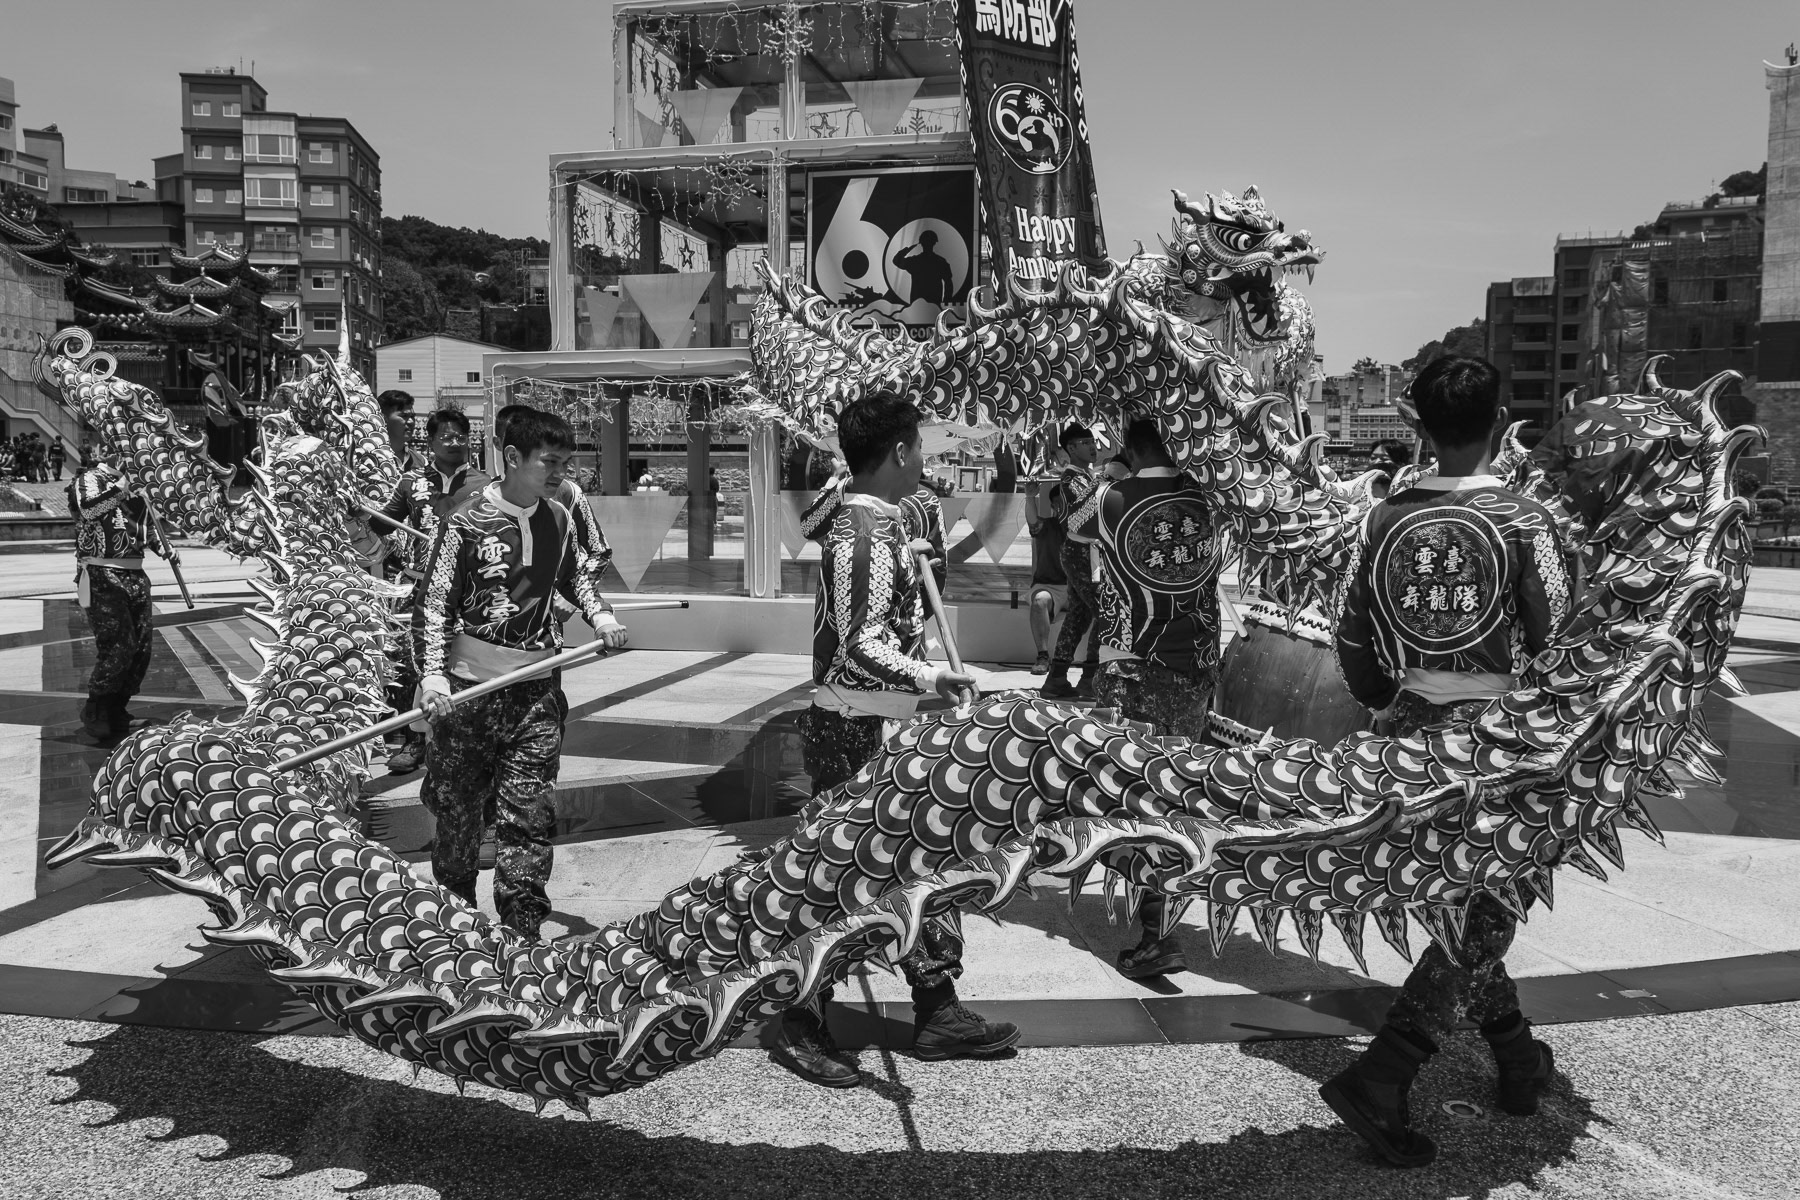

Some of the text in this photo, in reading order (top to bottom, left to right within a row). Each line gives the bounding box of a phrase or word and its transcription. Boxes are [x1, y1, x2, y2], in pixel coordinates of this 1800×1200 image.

[1014, 205, 1076, 254] Happy
[411, 477, 440, 530] 雲臺
[1153, 516, 1200, 542] 雲臺
[477, 535, 520, 622] 雲臺
[1414, 545, 1464, 574] 雲臺
[1399, 583, 1480, 613] 舞龍隊
